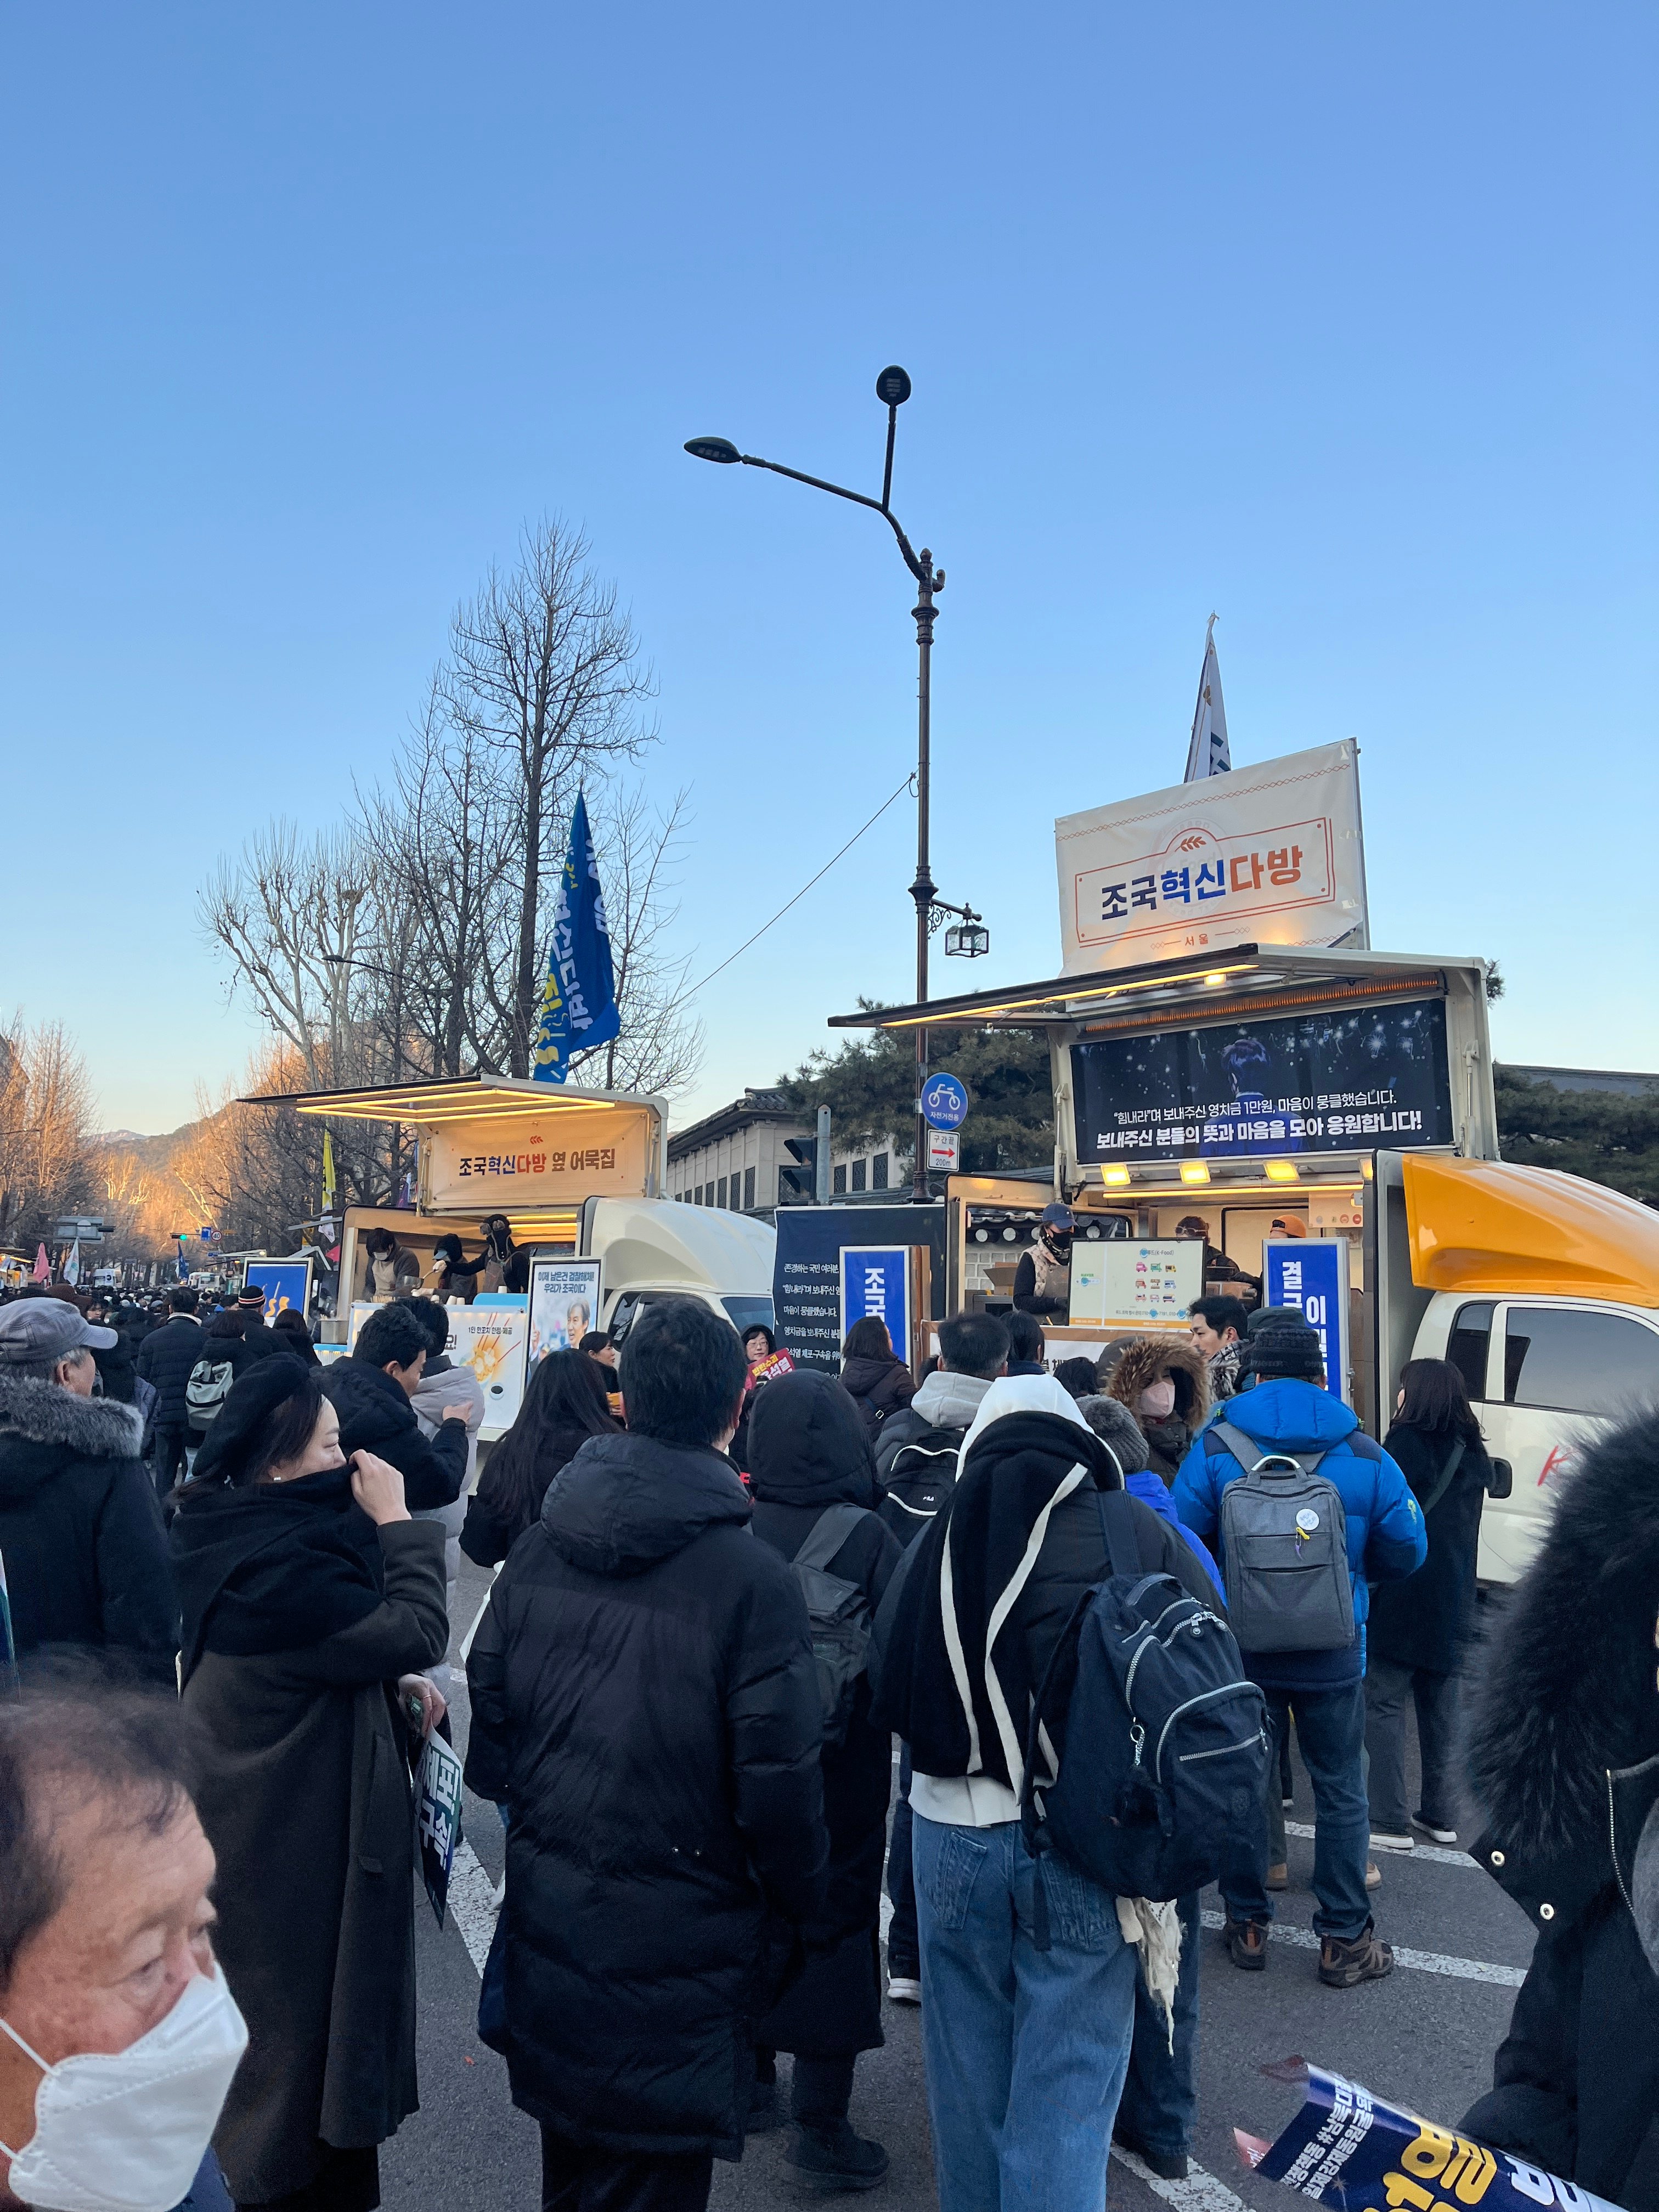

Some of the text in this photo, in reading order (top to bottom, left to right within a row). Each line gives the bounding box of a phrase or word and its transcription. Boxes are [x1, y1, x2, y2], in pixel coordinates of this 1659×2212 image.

[1101, 845, 1303, 921] 조국혁신다방
[1185, 934, 1208, 946] 서울
[1164, 1105, 1206, 1120] 보내주신
[1208, 1102, 1241, 1118] 영치금
[1244, 1099, 1276, 1115] 1만원,
[1278, 1097, 1313, 1111] 마음이
[1317, 1089, 1397, 1109] 뭉클했습니다.
[930, 1111, 960, 1121] 자전거전용
[1097, 1110, 1422, 1149] 보내주신 분들의 뜻과 마음을 모아 응원합니다!
[459, 1148, 615, 1176] 조국혁신다방 옆 어묵집
[936, 1158, 951, 1167] 200m
[784, 1263, 809, 1273] 존경하는
[809, 1263, 821, 1273] 국민
[538, 1272, 549, 1281] 이제
[544, 1283, 586, 1293] 우리가 조국이다
[812, 1285, 834, 1295] 보내주신
[783, 1305, 837, 1317] 마음이 뭉클했습니다.
[784, 1326, 806, 1337] 영치금을
[807, 1328, 830, 1338] 보내주신
